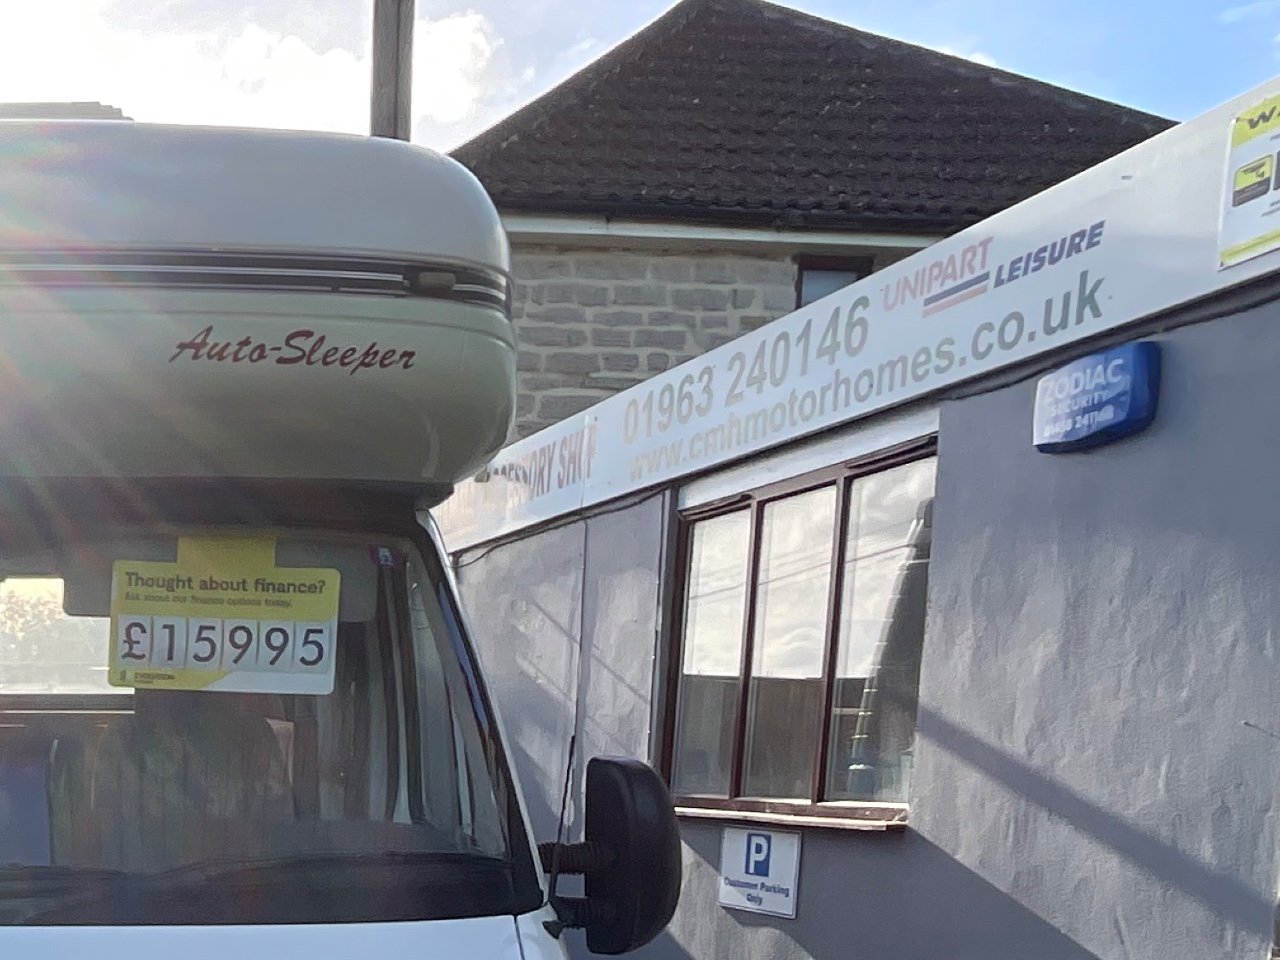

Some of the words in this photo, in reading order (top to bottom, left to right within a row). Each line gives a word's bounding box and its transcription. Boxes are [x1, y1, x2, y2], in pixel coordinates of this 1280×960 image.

[1247, 104, 1280, 130] W
[883, 236, 994, 311] UNIPART
[993, 220, 1107, 289] LEISURE
[168, 325, 417, 375] Auto-Sleeper
[623, 365, 715, 445] 01963
[724, 295, 872, 408] 240146
[628, 270, 1107, 483] www.cmhmotorhomes.co.uk
[1044, 358, 1125, 400] ZODIAC
[125, 571, 195, 592] Thought
[199, 575, 248, 593] about
[254, 577, 327, 595] finance?
[120, 621, 325, 667] £15995
[748, 835, 768, 874] P
[746, 893, 763, 906] Only
[759, 882, 790, 898] Parking
